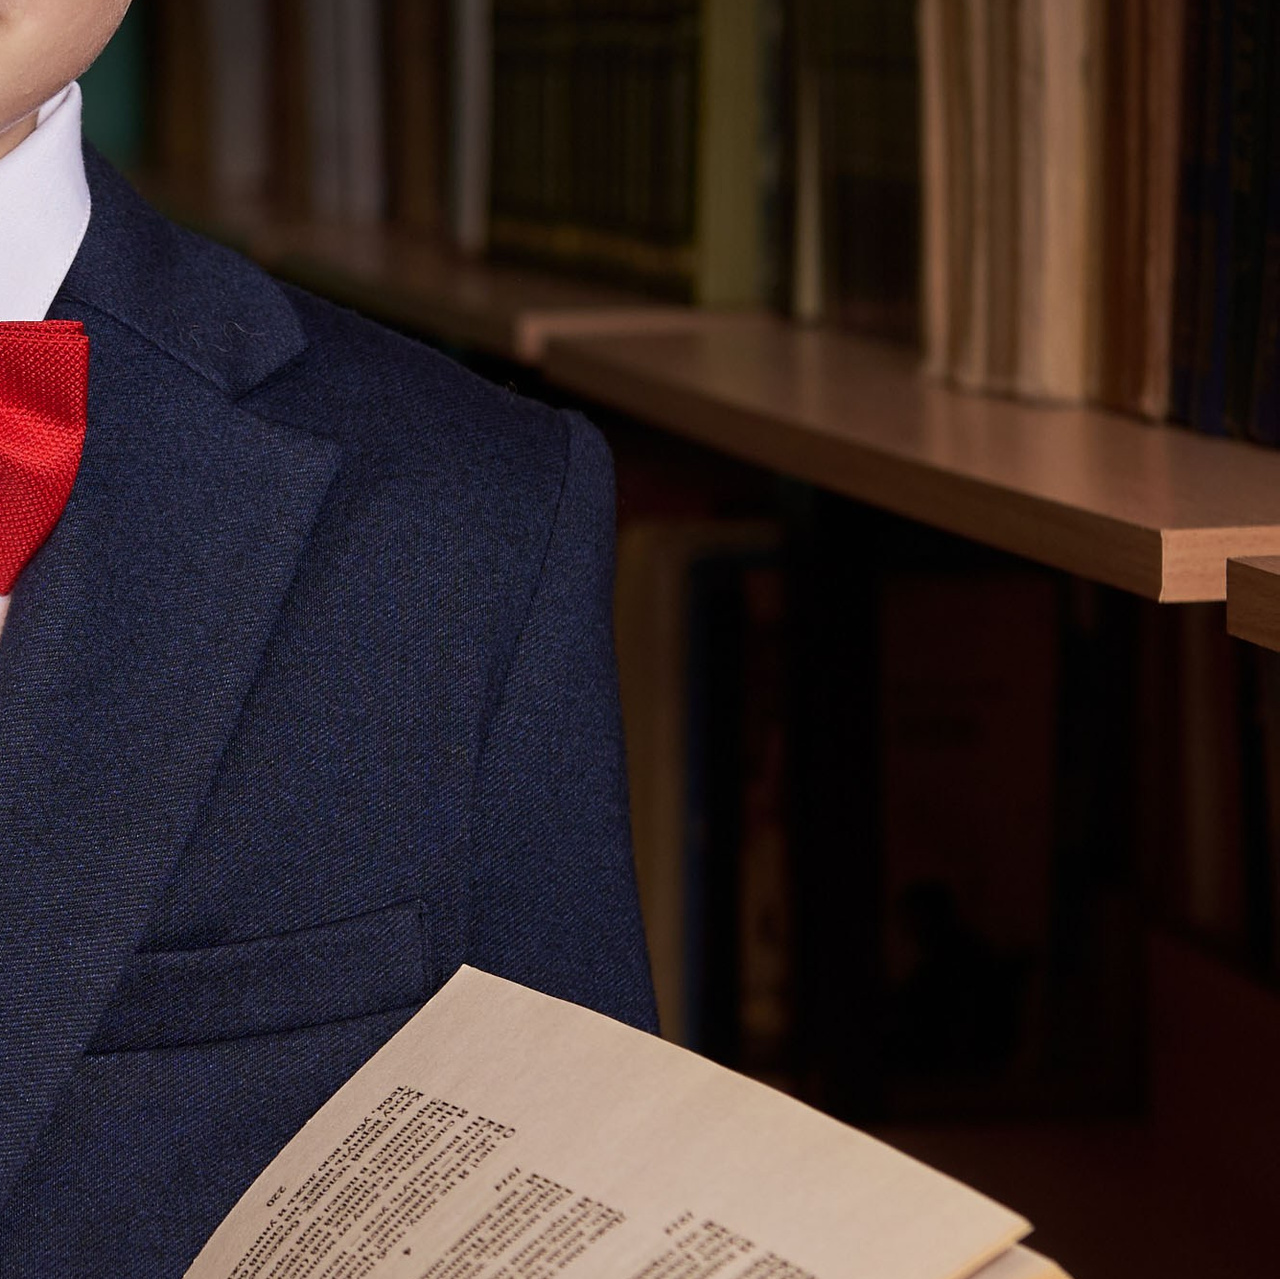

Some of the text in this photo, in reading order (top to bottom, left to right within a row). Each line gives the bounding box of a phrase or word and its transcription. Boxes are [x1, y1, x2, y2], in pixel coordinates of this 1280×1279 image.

[379, 1086, 418, 1119] Хочу
[395, 1091, 426, 1116] Как
[426, 1100, 452, 1120] Ни
[435, 1104, 461, 1124] Ни
[455, 1108, 470, 1120] Я
[334, 1118, 384, 1167] вернуть
[341, 1115, 374, 1148] убив
[349, 1116, 399, 1163] первый
[367, 1097, 442, 1165] Зарывшись
[397, 1119, 456, 1174] слепнуть
[317, 1146, 344, 1172] всю
[367, 1120, 428, 1178] испытать
[383, 1124, 437, 1175] слушать
[298, 1167, 337, 1206] навек
[358, 1166, 370, 1175] в
[381, 1174, 400, 1192] не
[266, 1186, 287, 1208] 220
[286, 1172, 318, 1207] ложь
[321, 1179, 370, 1228] прибой
[322, 1175, 361, 1214] пепел
[331, 1175, 385, 1230] скрипок
[276, 1207, 289, 1218] и
[283, 1205, 302, 1223] на
[352, 1191, 383, 1223] хочу
[294, 1214, 325, 1246] твой
[309, 1230, 333, 1256] вой
[337, 1222, 353, 1239] от
[248, 1224, 289, 1269] синий
